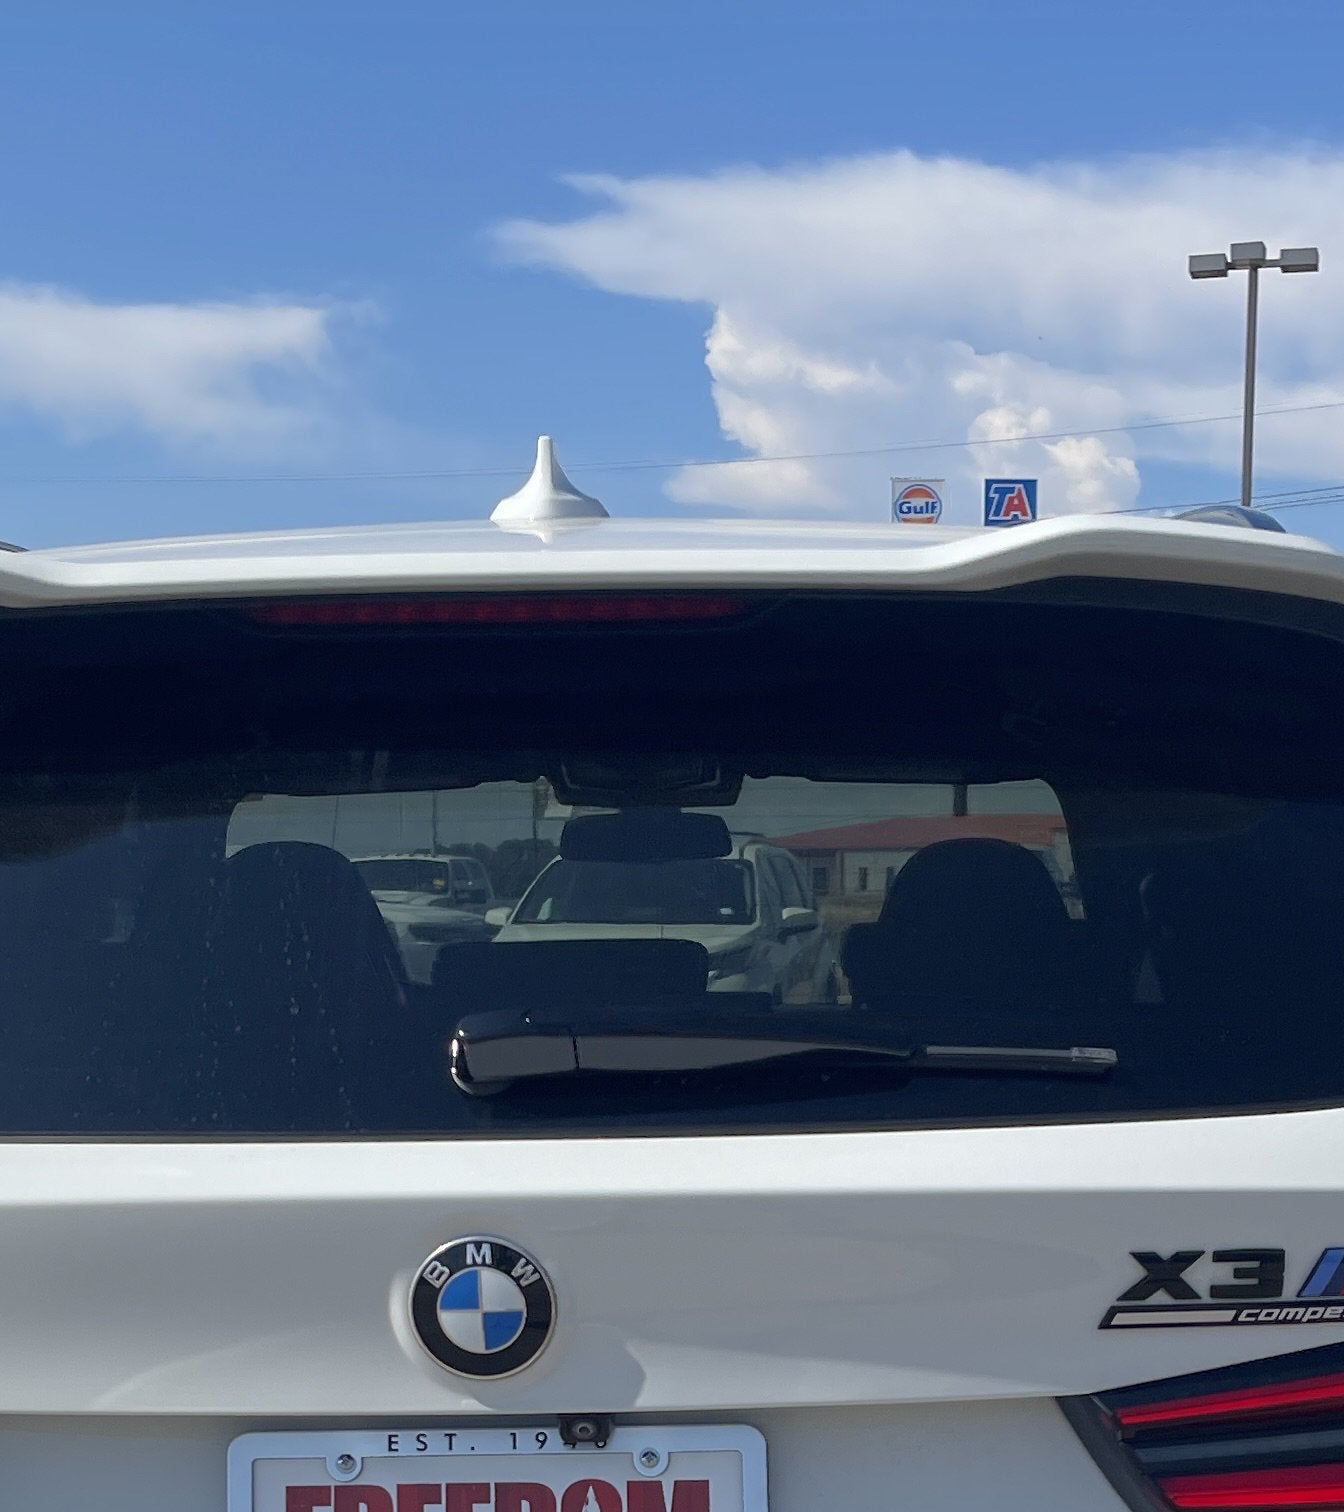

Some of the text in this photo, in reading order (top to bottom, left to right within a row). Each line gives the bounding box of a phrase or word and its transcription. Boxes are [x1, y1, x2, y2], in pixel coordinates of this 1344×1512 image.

[898, 501, 938, 515] Gulf
[988, 483, 1033, 521] TA
[422, 1242, 542, 1289] BMW
[1116, 1248, 1286, 1301] X3
[387, 1433, 476, 1452] EST.
